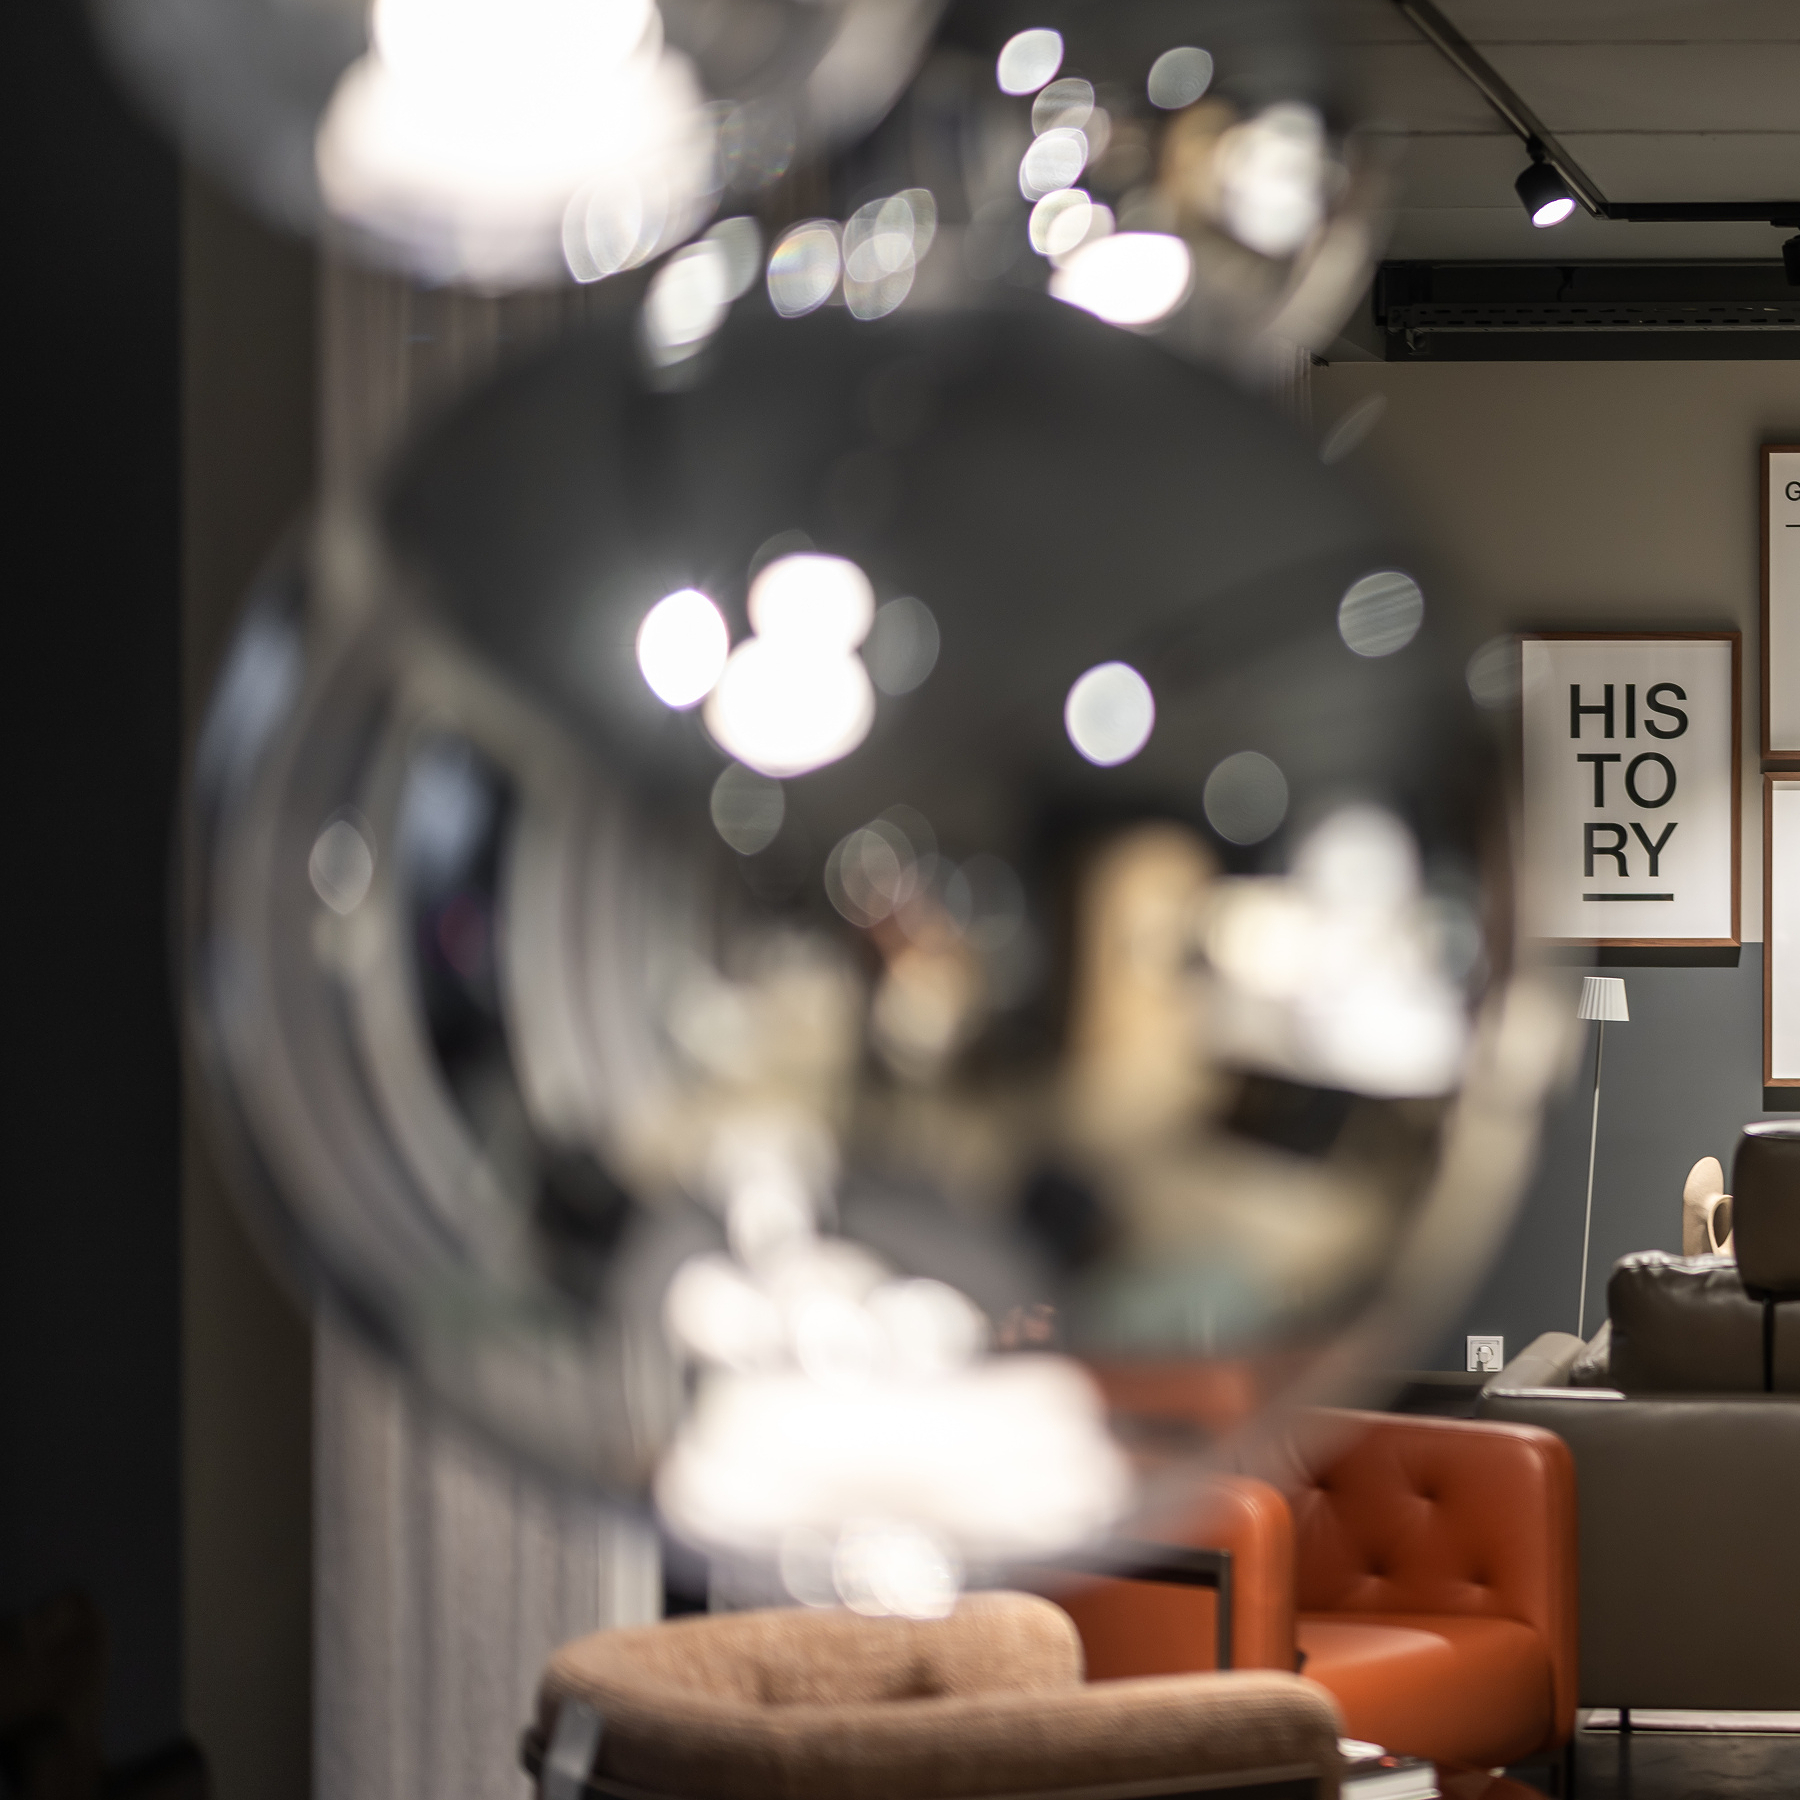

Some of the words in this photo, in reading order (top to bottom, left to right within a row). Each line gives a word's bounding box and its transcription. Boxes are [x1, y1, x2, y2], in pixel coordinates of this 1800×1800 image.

[1569, 682, 1689, 740] HIS
[1576, 751, 1677, 809] TO
[1583, 822, 1679, 878] RY
